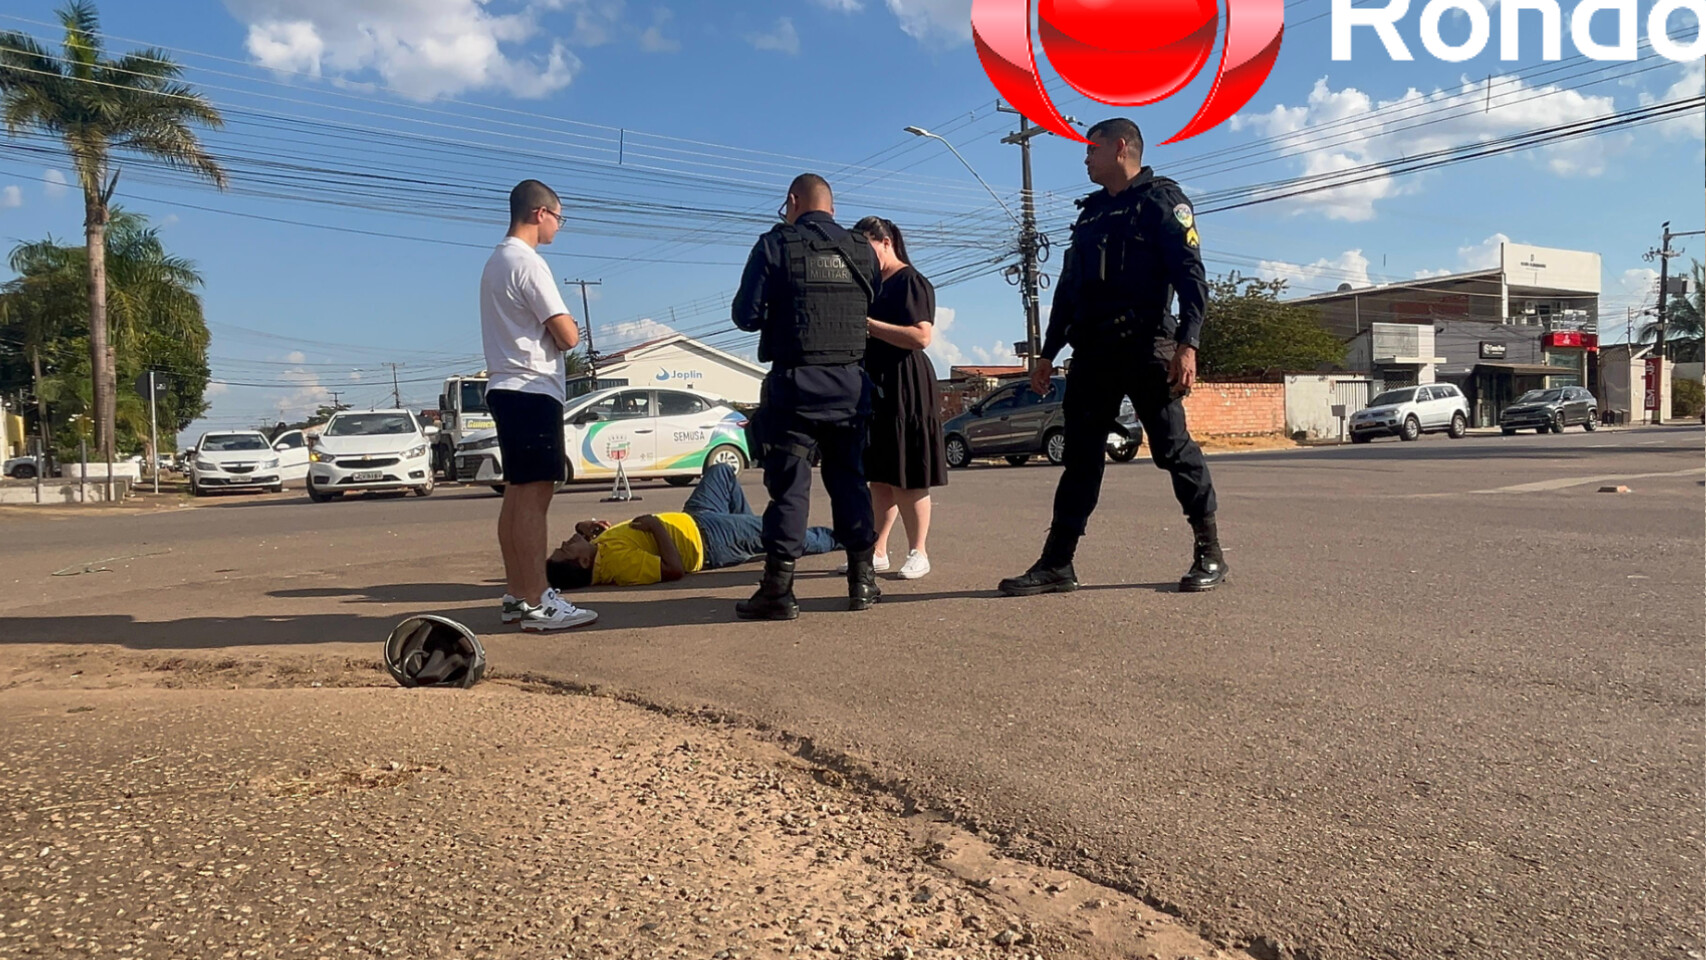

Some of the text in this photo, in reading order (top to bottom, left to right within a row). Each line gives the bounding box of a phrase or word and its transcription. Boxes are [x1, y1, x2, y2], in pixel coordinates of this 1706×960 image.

[810, 269, 848, 279] MILITAR
[671, 369, 703, 381] Joplin
[673, 430, 705, 442] SEMUSA
